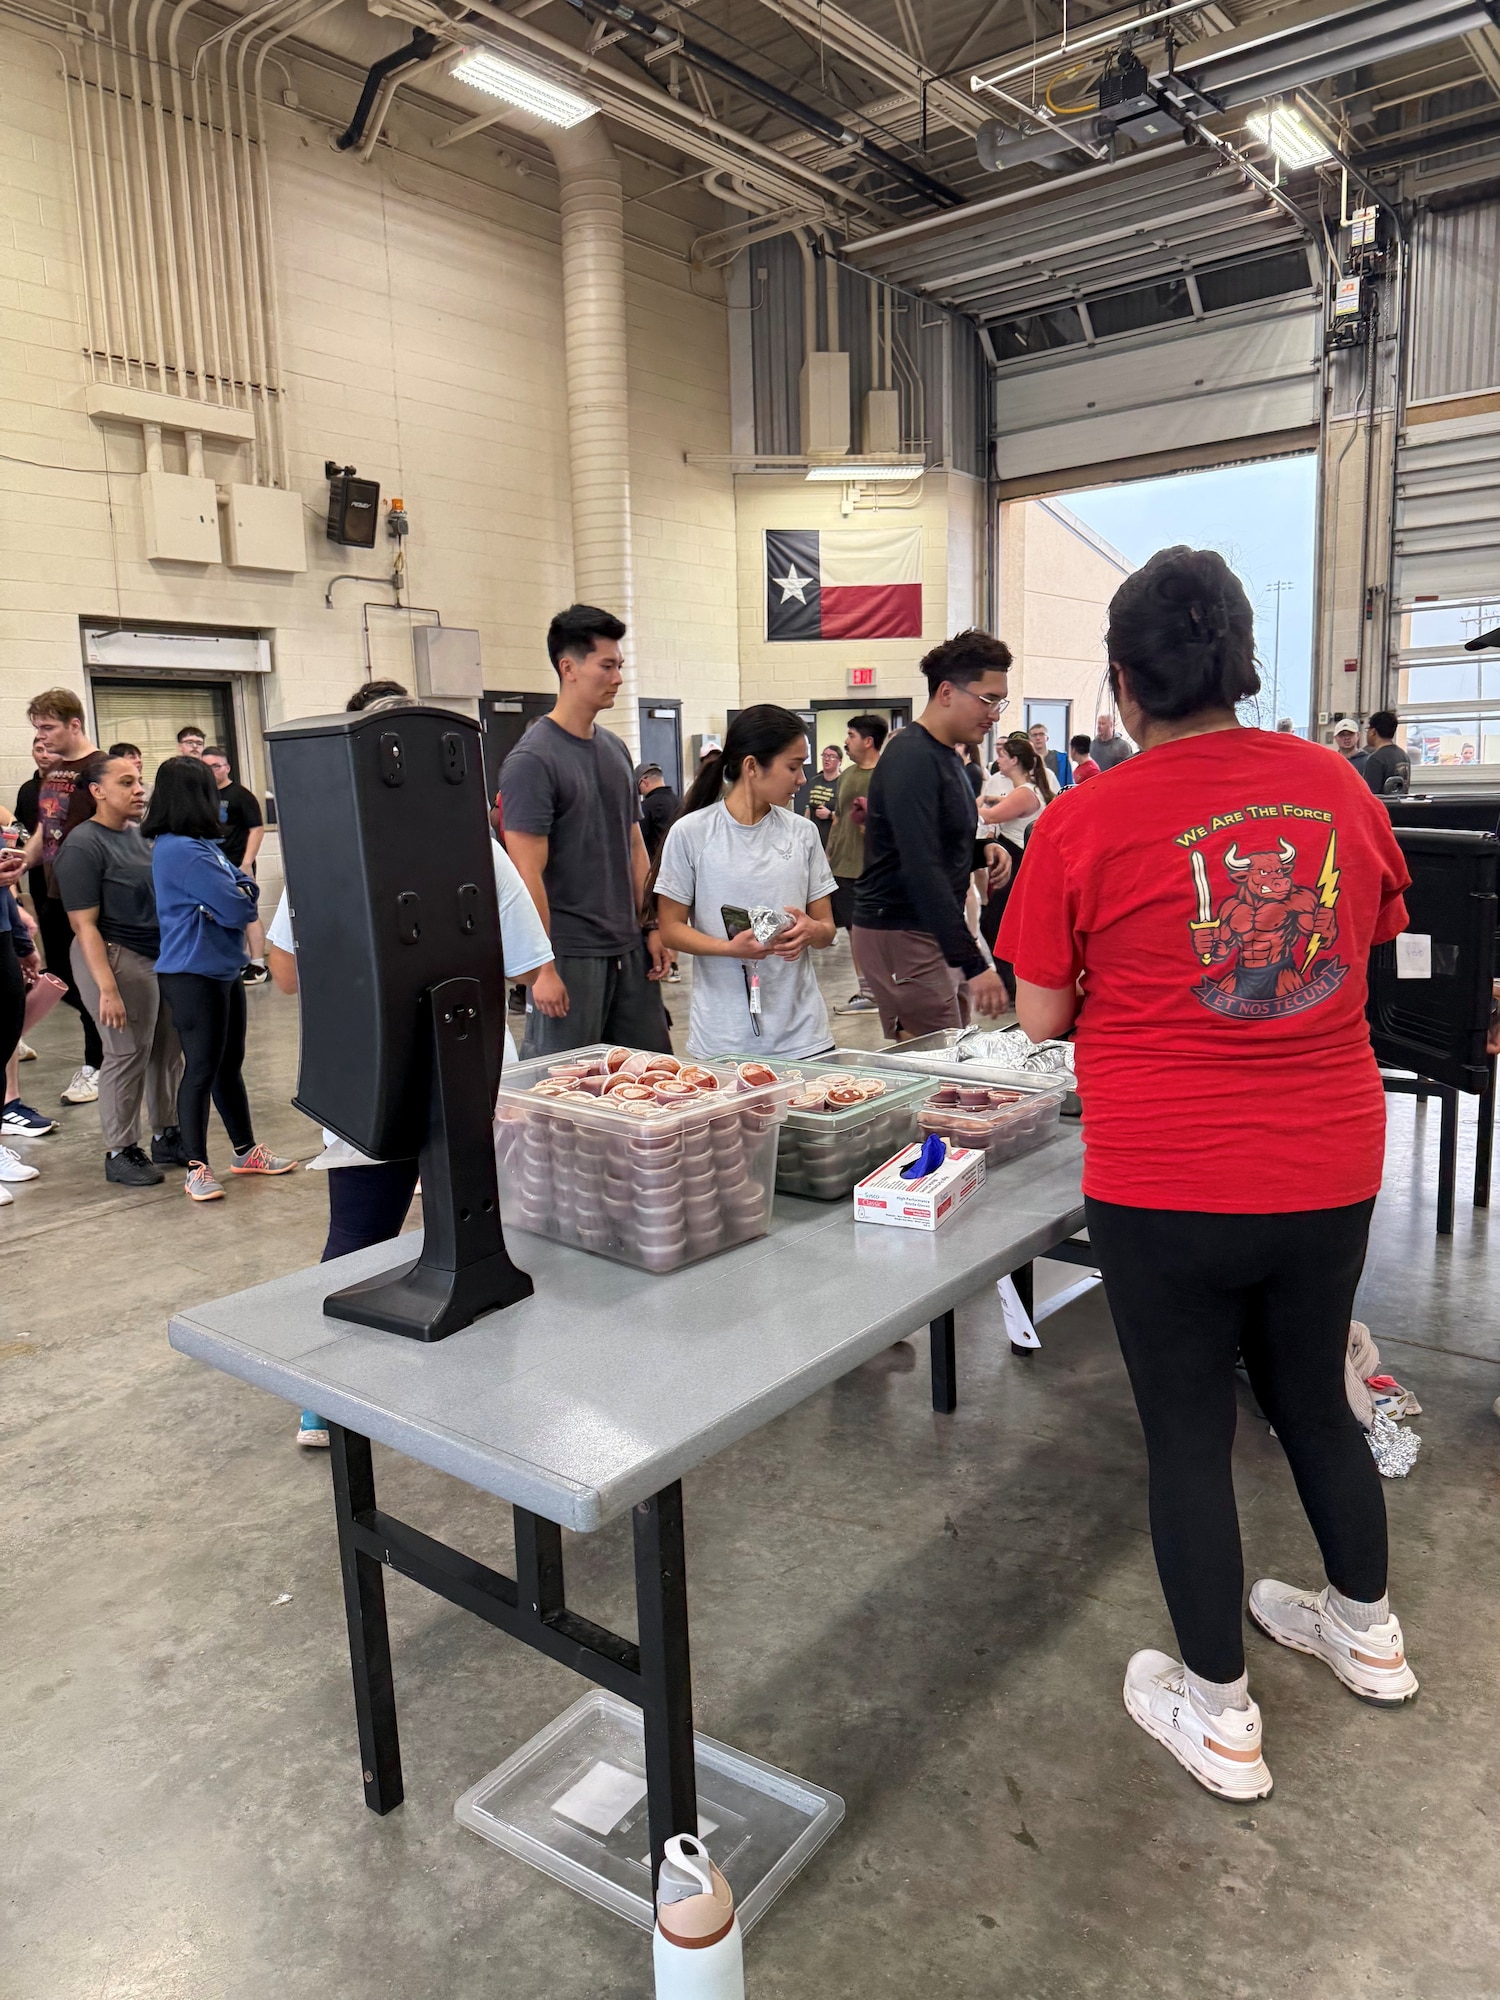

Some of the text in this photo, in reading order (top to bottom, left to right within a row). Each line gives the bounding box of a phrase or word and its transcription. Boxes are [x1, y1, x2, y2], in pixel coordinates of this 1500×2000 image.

[853, 668, 873, 684] EXIT
[1215, 981, 1330, 1015] ET NOS TECUM
[862, 1199, 882, 1208] Classic
